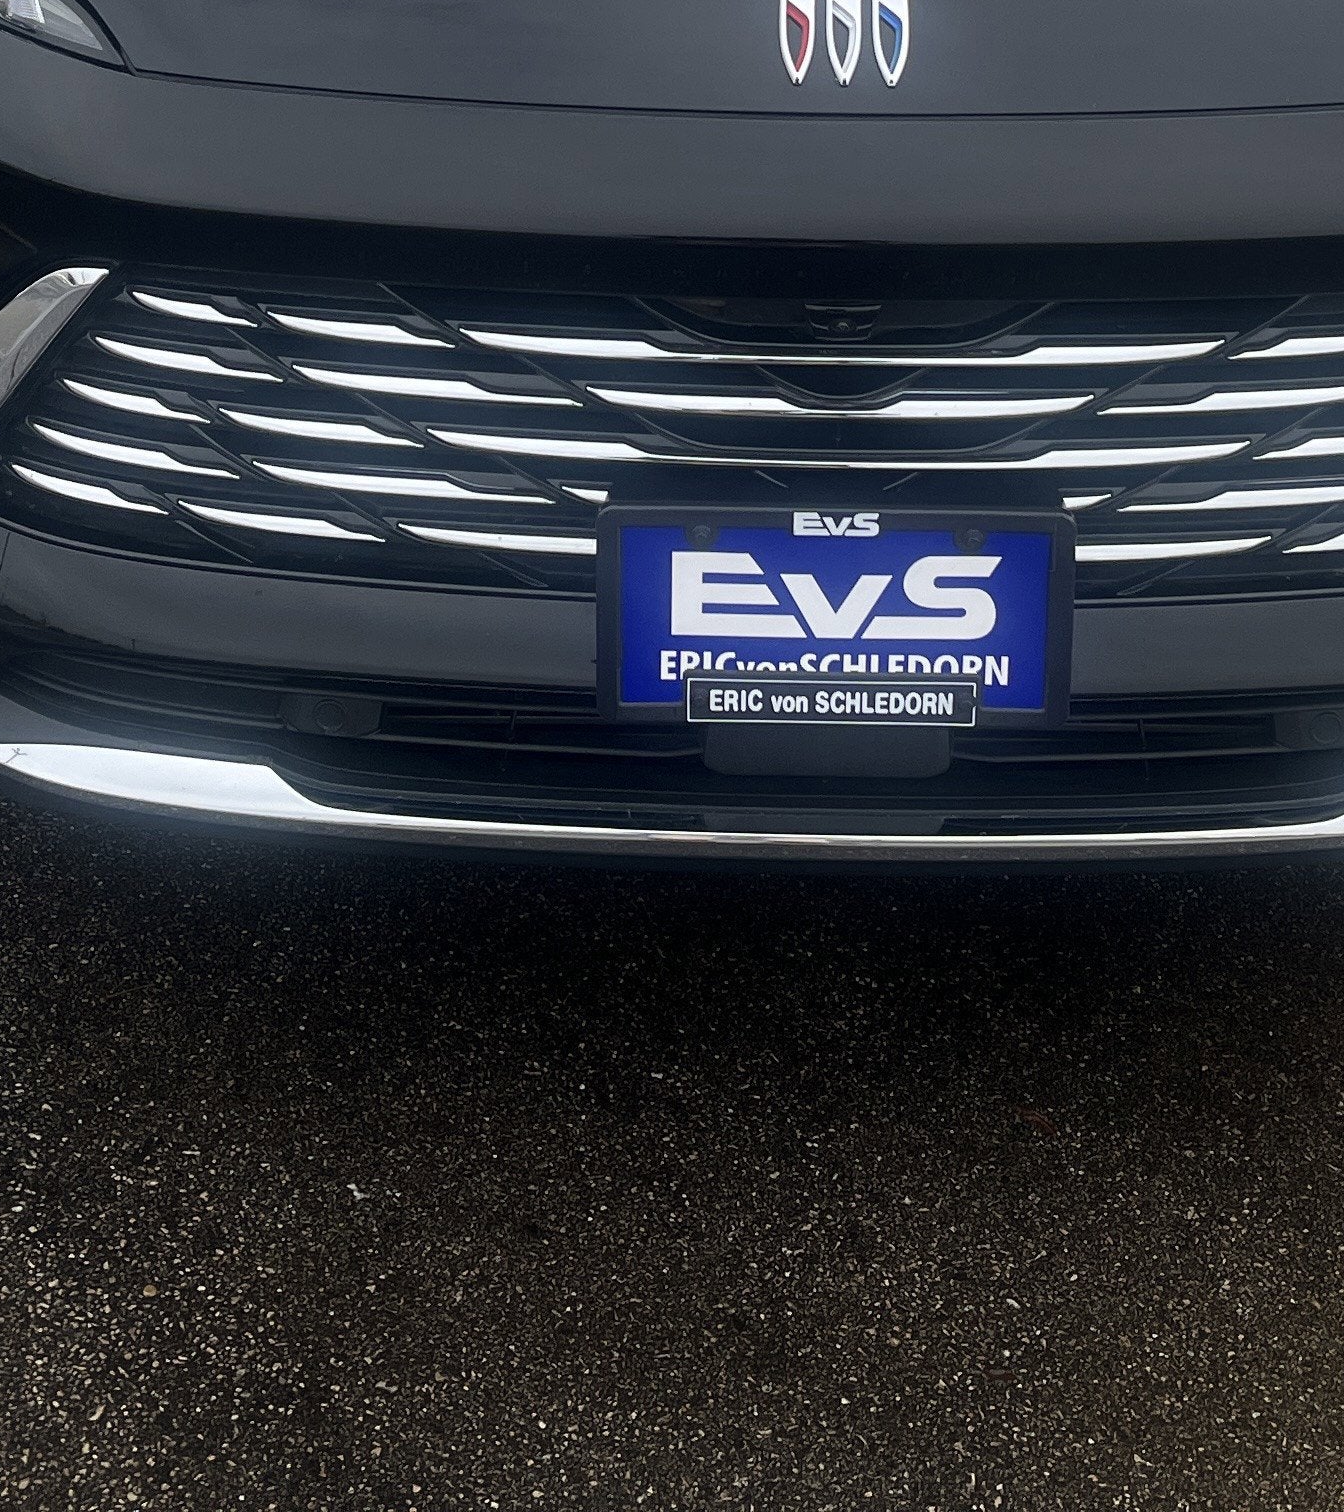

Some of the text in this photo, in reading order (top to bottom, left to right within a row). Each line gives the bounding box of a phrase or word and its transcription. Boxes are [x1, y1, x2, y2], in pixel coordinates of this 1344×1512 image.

[709, 689, 954, 716] ERIC von SCHLEDORN
